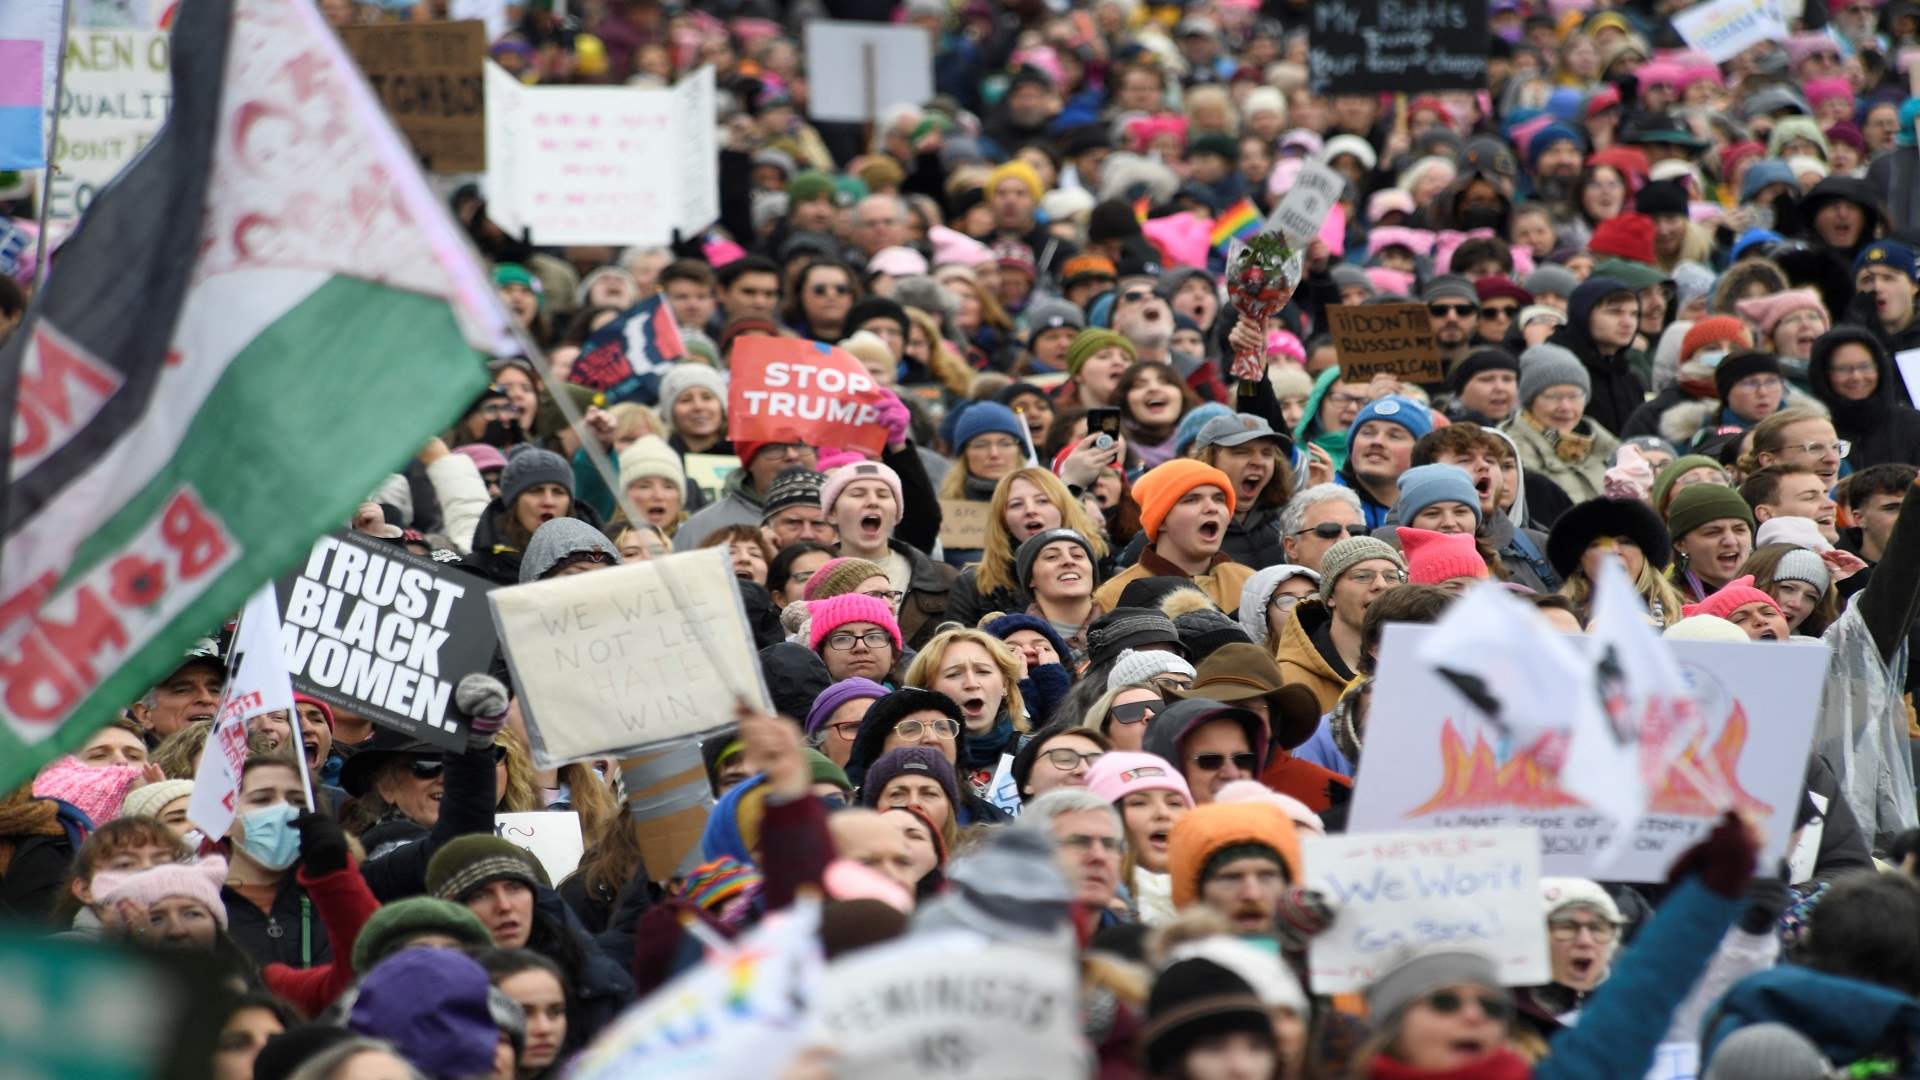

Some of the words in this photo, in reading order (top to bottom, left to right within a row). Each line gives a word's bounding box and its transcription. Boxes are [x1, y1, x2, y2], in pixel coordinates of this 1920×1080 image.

[46, 84, 172, 120] QUALIT
[764, 361, 873, 396] STOP
[743, 390, 880, 426] TRUMP
[304, 535, 465, 629] TRUST
[285, 575, 450, 678] BLACK
[540, 602, 598, 637] WE
[611, 583, 707, 622] WILL
[555, 630, 633, 671] NOT
[657, 614, 720, 648] LET
[281, 621, 458, 733] WOMEN.
[586, 650, 706, 703] HATE
[617, 693, 700, 732] WIN
[1541, 836, 1588, 855] YOU
[1325, 867, 1407, 904] We
